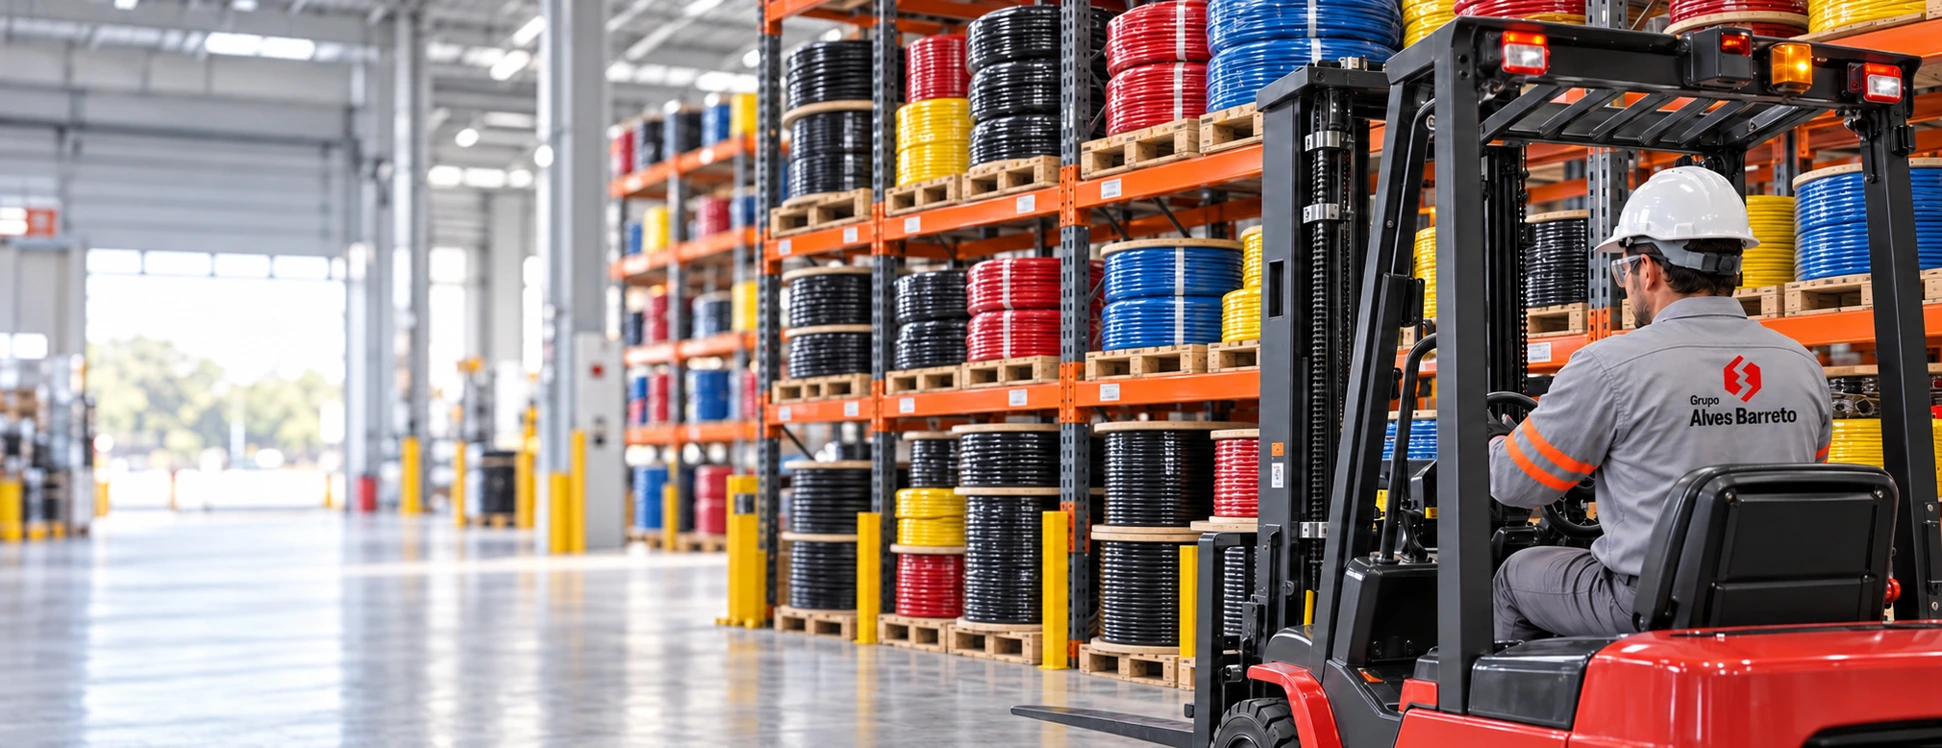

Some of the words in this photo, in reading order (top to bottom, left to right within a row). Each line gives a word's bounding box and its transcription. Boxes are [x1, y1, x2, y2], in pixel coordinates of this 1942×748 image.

[1690, 395, 1719, 407] Grupo
[1689, 408, 1733, 426] Alves
[1735, 407, 1797, 425] Barreto
